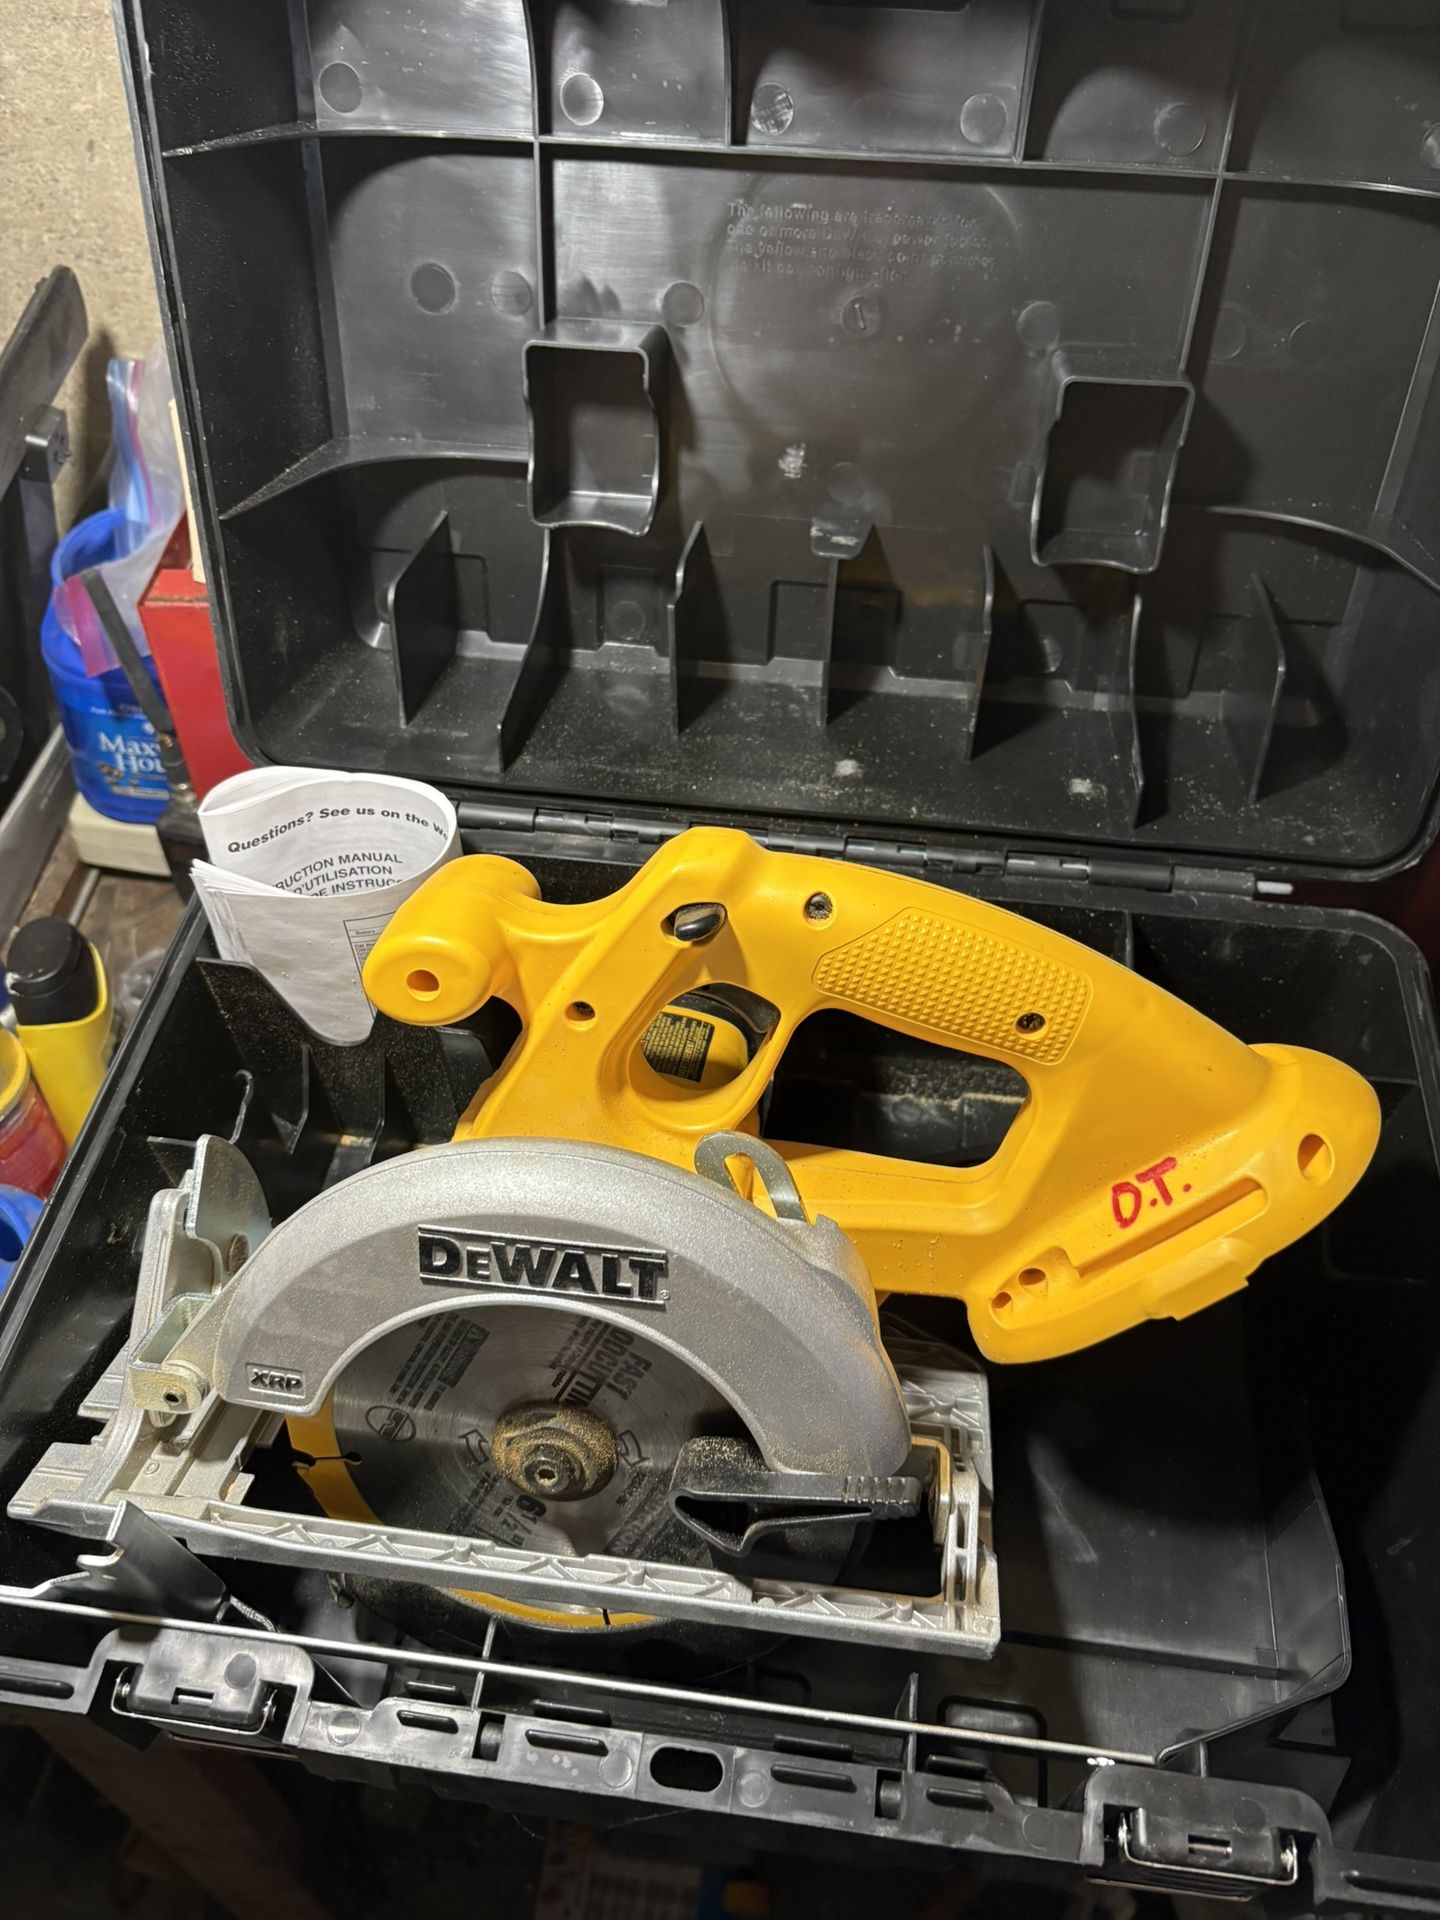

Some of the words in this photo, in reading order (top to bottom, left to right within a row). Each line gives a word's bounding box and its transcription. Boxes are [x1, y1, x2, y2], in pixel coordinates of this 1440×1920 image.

[761, 203, 829, 225] following
[227, 811, 315, 853] Questions?
[319, 807, 350, 819] See
[356, 807, 375, 816] us
[381, 809, 400, 819] on
[405, 812, 429, 827] the
[272, 857, 334, 892] RUCTION
[338, 852, 403, 865] MANUAL
[332, 878, 404, 894] INSTRUC
[249, 1368, 304, 1392] XRP
[564, 1325, 635, 1408] ODCUTTIN
[605, 1351, 653, 1401] FAST
